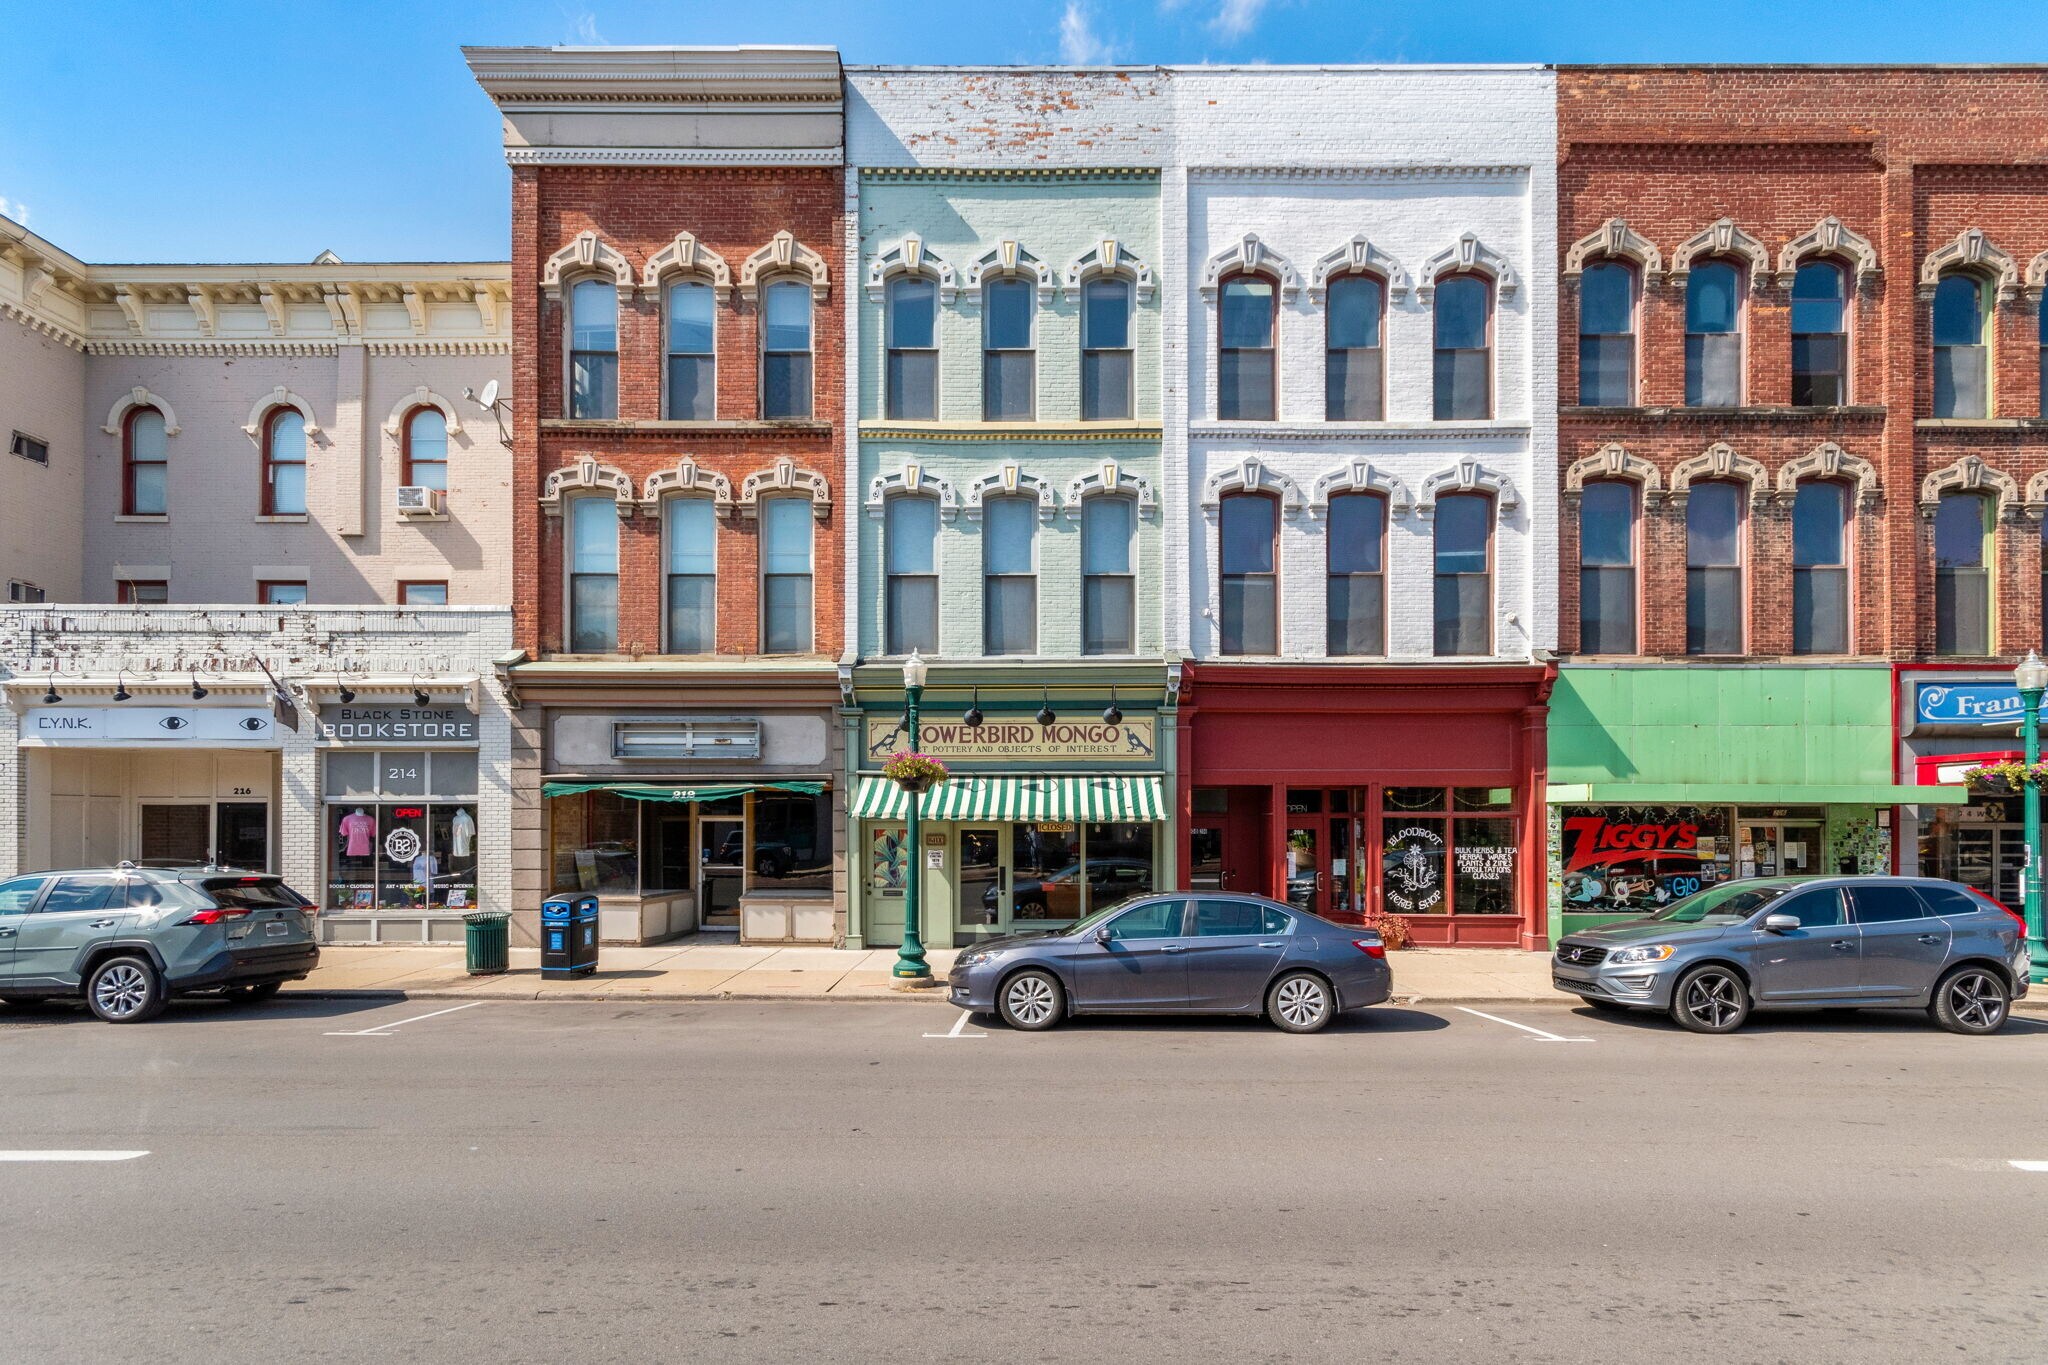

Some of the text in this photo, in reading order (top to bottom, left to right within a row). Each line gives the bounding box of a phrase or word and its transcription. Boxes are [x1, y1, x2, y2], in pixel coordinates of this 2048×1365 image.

[1956, 696, 2025, 716] Fran
[342, 709, 454, 720] BLACK STONE
[39, 717, 92, 729] C.Y.N.K.
[323, 723, 472, 737] BOOKSTORE
[919, 726, 1120, 744] OWERBIRD MONGO
[933, 745, 973, 753] POTTERY
[998, 745, 1042, 753] OBJECTS
[1048, 745, 1059, 753] OF
[1066, 745, 1117, 753] INTEREST
[388, 768, 417, 779] 214
[233, 787, 252, 795] 216
[395, 808, 422, 818] OPEN
[1041, 823, 1072, 831] CLOSED
[1387, 827, 1443, 846] BLOODROOT
[1564, 816, 1699, 874] ZIGGY'S
[1418, 890, 1441, 910] SHOP
